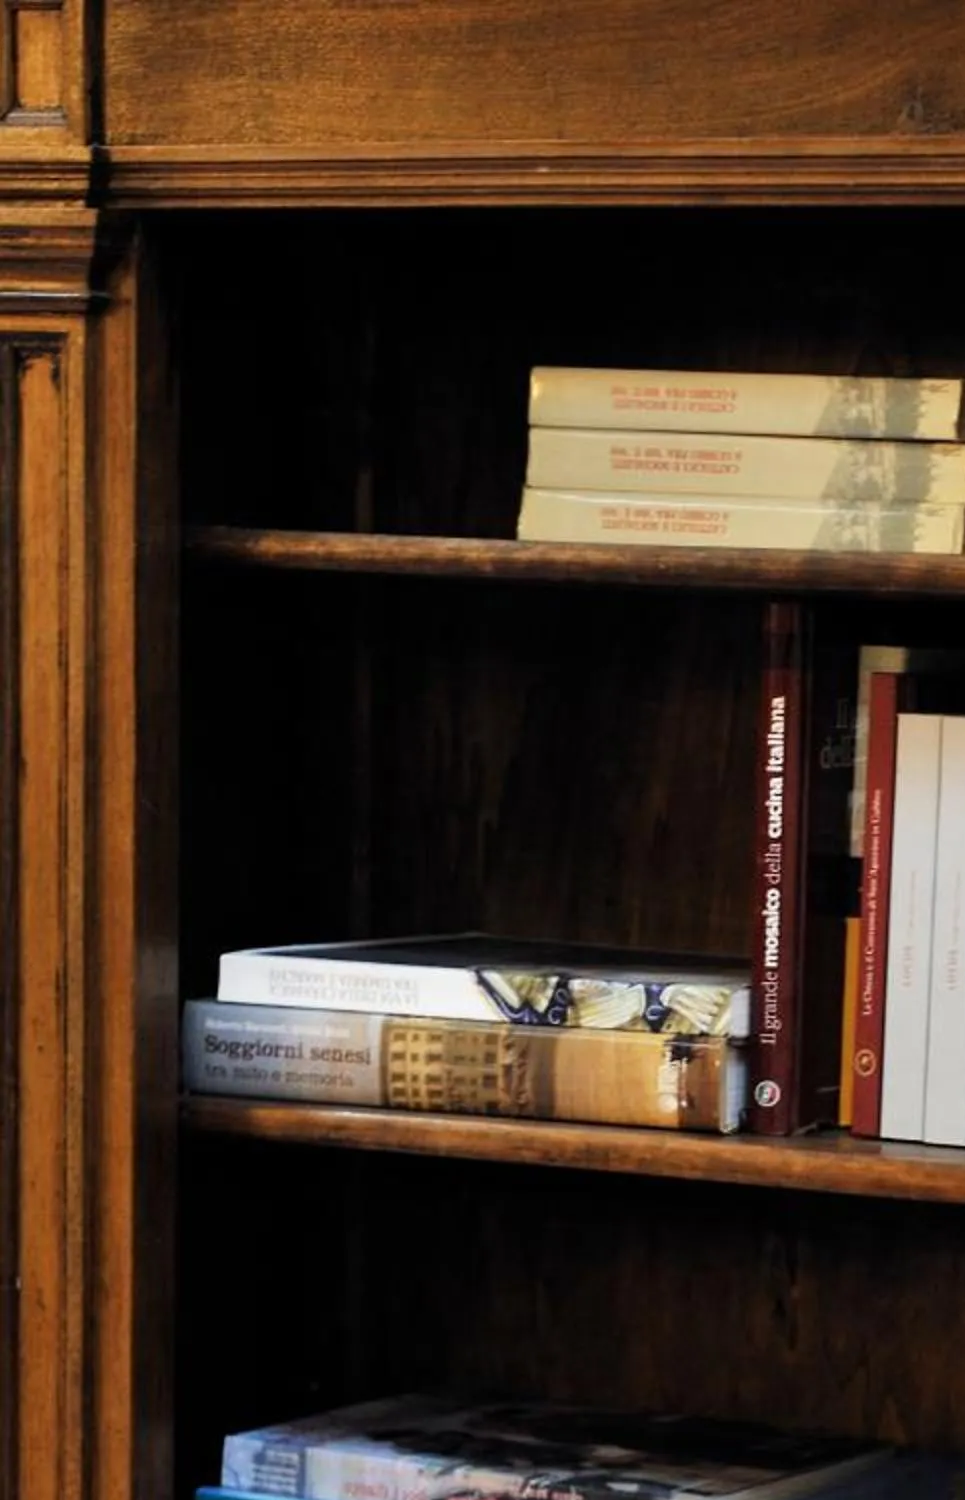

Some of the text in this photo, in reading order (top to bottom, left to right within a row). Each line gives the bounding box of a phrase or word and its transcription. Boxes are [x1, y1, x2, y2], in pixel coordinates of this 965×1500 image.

[761, 695, 787, 1046] Il grande mosaico della cucina italiana
[204, 1034, 372, 1066] Soggiorni senesi
[205, 1063, 227, 1078] tra
[271, 1071, 281, 1082] e
[285, 1071, 354, 1088] memoria
